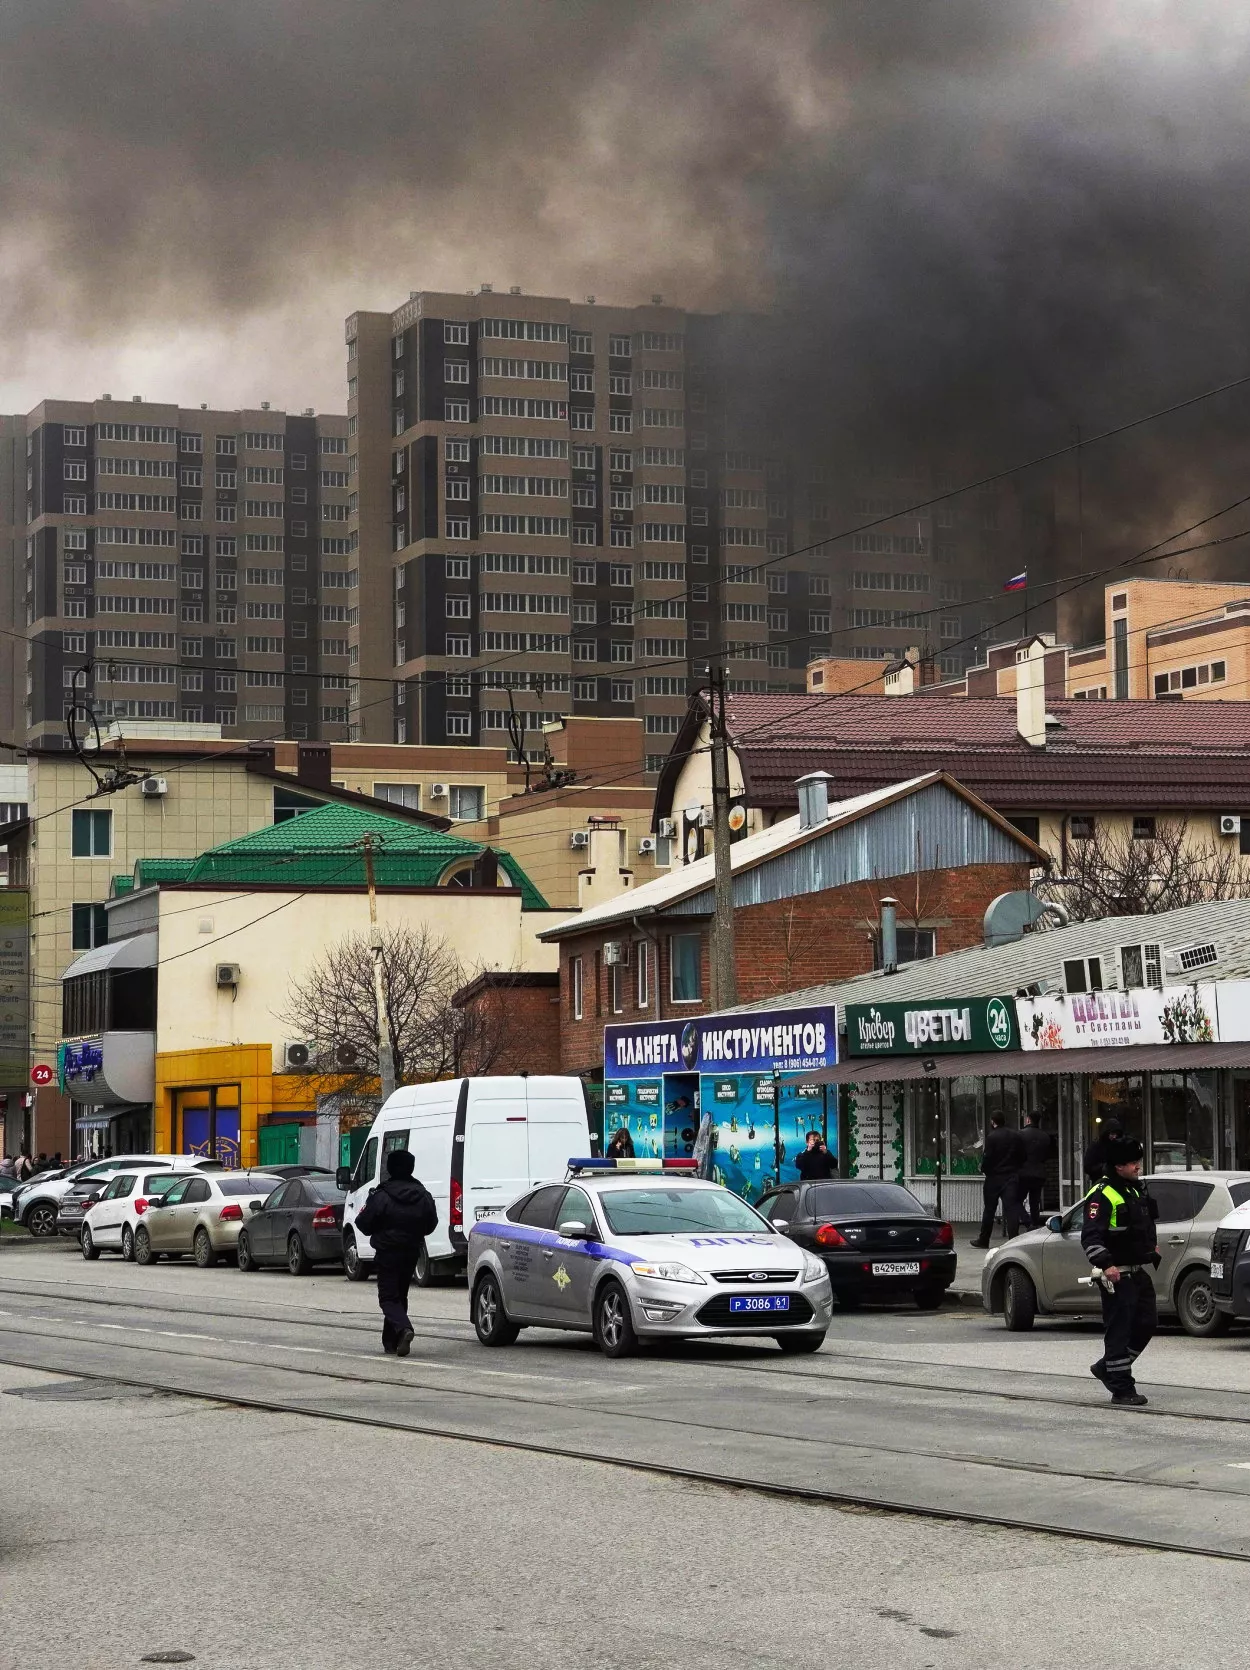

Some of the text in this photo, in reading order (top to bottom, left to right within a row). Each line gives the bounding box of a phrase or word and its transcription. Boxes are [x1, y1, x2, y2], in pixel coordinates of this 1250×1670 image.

[858, 1008, 1007, 1048] Клевер ЦВЕТЫ 24
[1076, 1021, 1141, 1033] от Светланы
[995, 1034, 1007, 1042] часа
[616, 1023, 826, 1066] ПЛАНЕТА ИНСТРУМЕНТОВ
[875, 1041, 889, 1049] цветов
[37, 1070, 49, 1079] 24
[690, 1237, 774, 1248] ДПС
[735, 1297, 786, 1310] Р 3086 61
